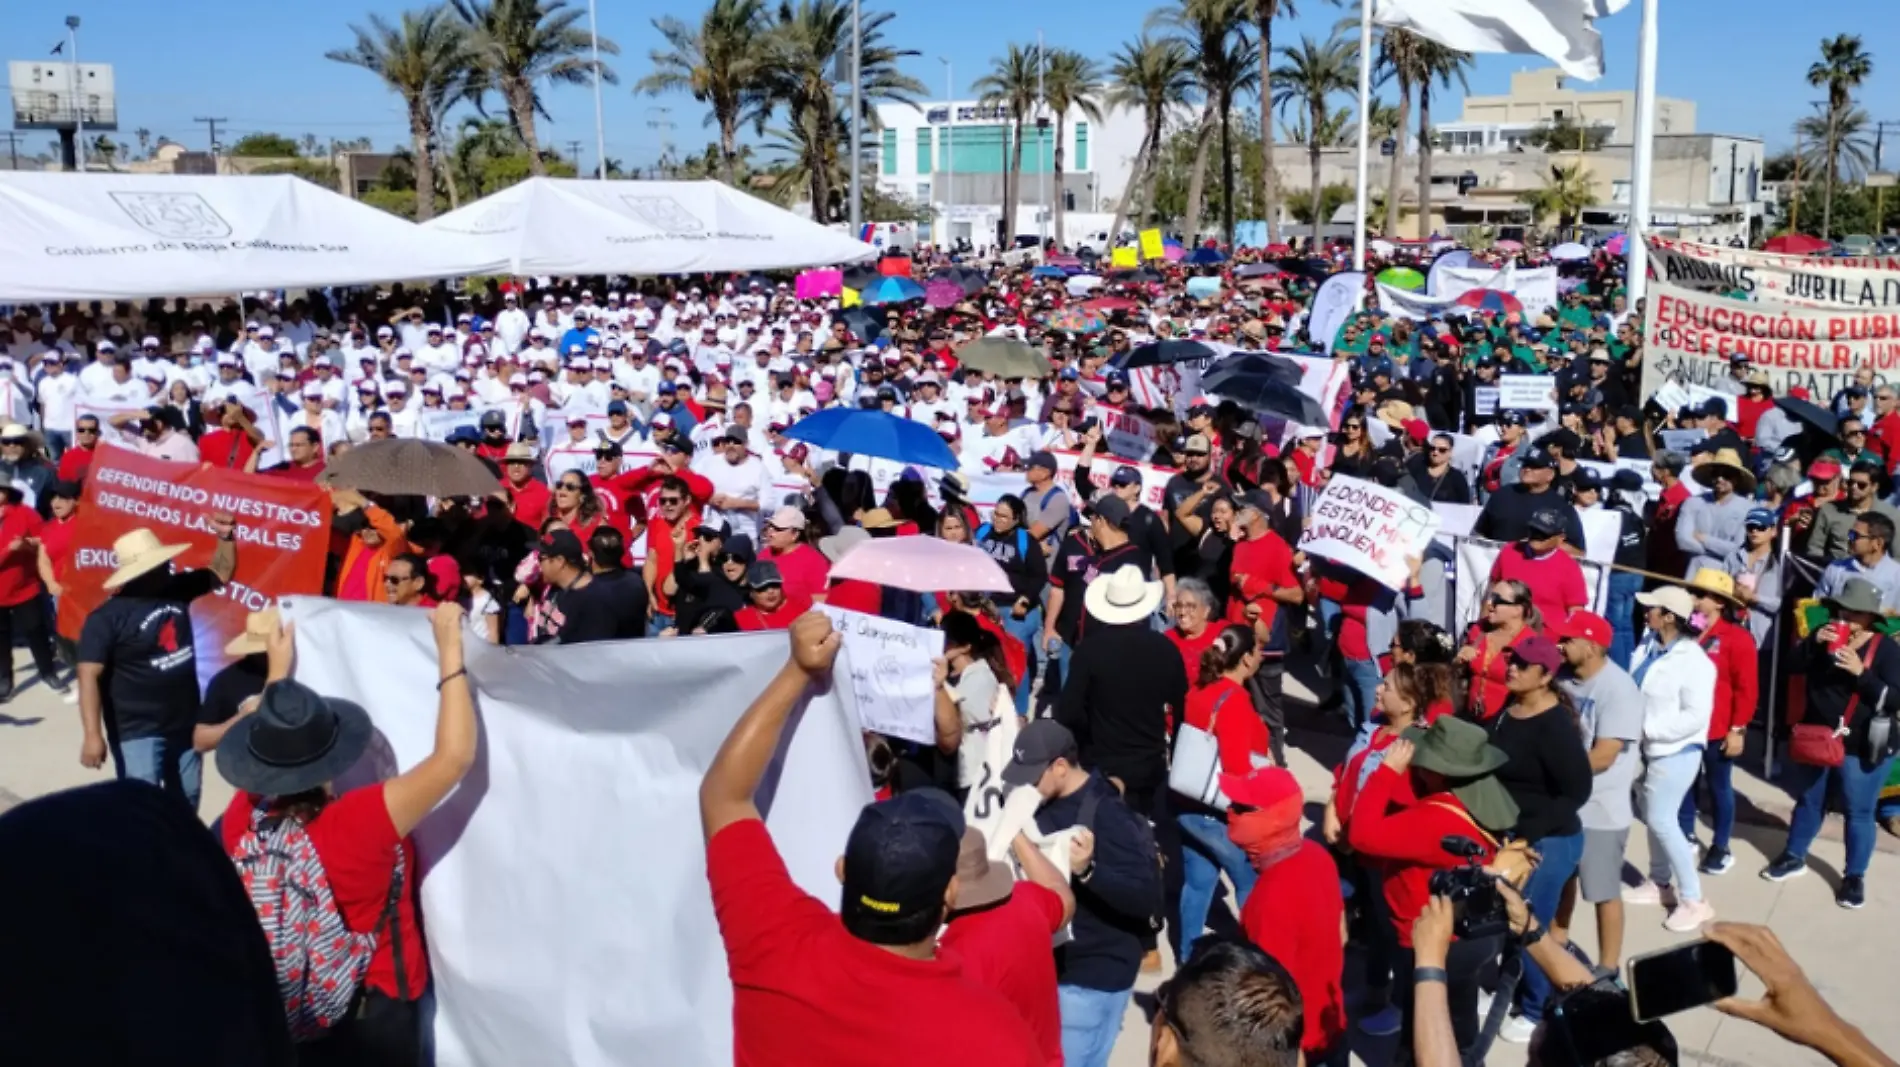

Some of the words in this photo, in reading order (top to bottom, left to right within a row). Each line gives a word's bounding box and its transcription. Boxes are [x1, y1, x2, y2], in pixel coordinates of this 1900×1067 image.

[45, 243, 147, 257] Gobierno
[153, 240, 179, 252] de
[183, 241, 227, 254] Baja
[1658, 294, 1817, 342] EDUCACIÓN
[96, 467, 208, 504] DEFENDIENDO
[212, 493, 321, 527] NUESTROS
[97, 491, 181, 526] DERECHOS
[184, 515, 302, 551] LABRALES
